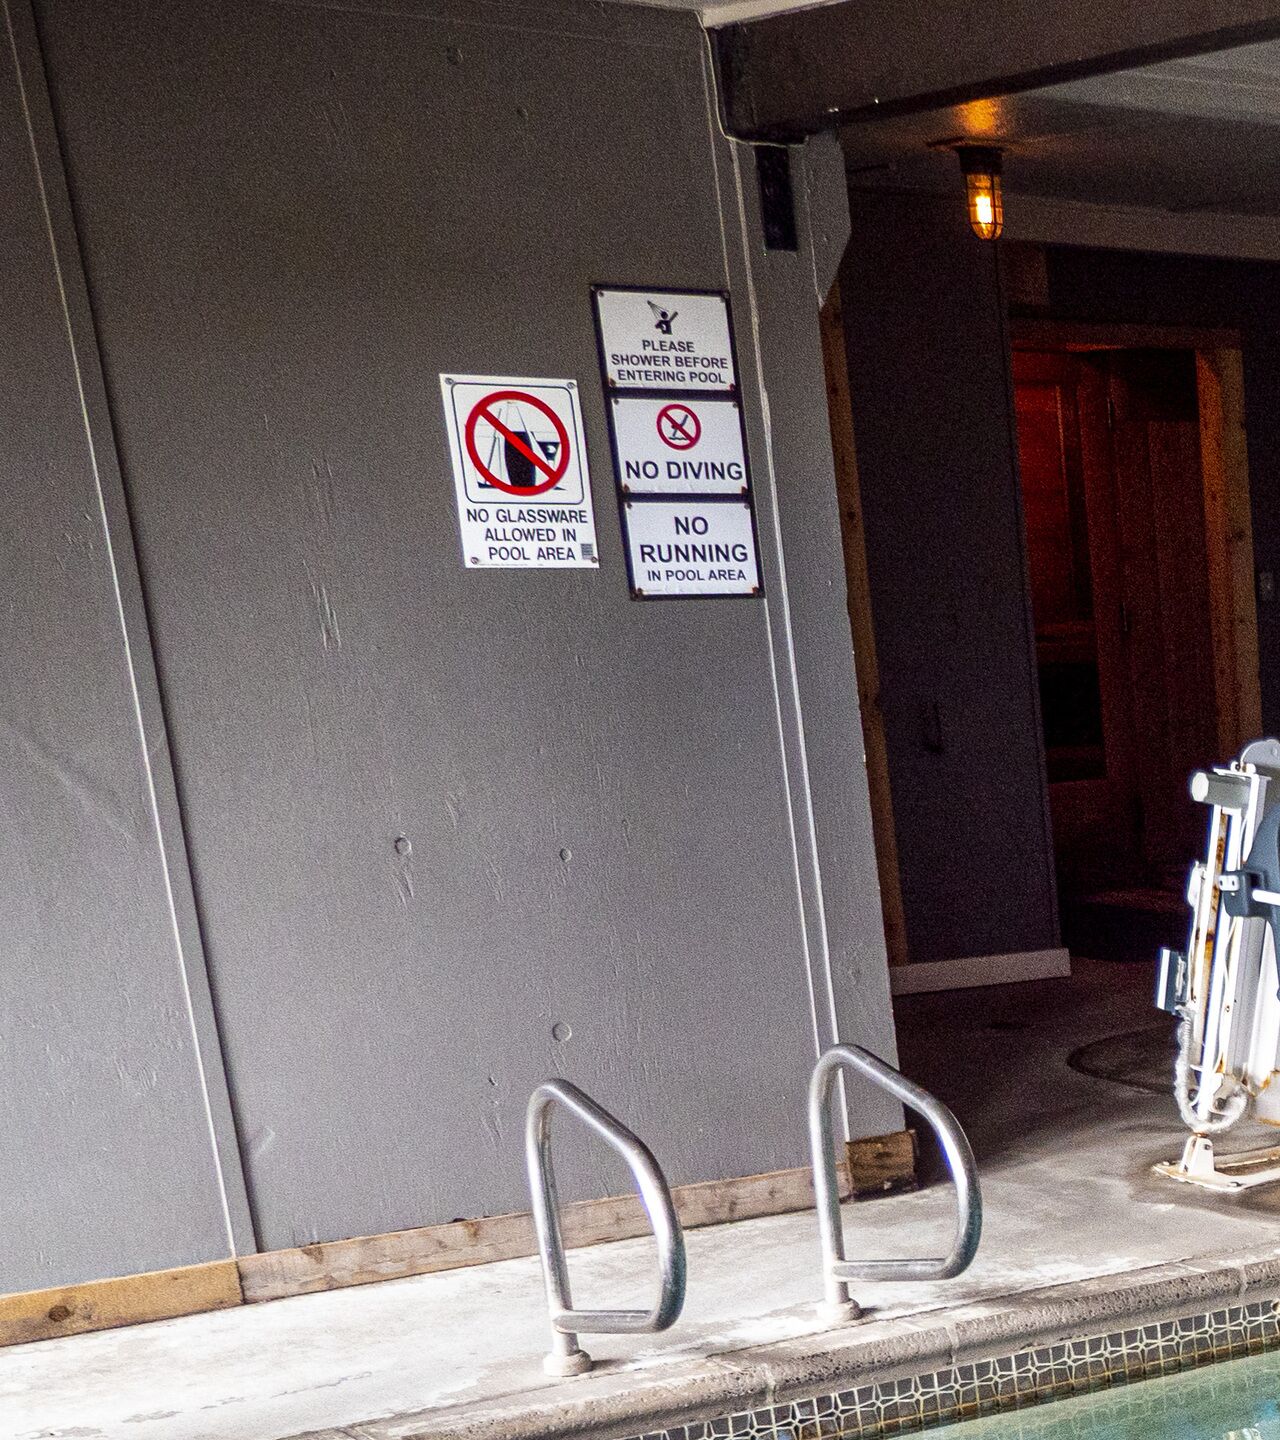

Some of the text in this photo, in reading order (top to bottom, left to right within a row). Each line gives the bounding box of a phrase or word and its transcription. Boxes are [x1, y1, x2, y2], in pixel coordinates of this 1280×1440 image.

[642, 340, 695, 353] PLEASE
[611, 354, 728, 369] SHOWER BEFORE
[617, 369, 726, 384] ENTERING POOL
[625, 460, 743, 480] NO DIVING
[467, 508, 588, 524] NO GLASSWARE
[675, 516, 709, 535] NO
[485, 528, 577, 542] ALLOWED IN
[488, 546, 530, 561] POOL
[537, 547, 576, 561] AREA
[640, 544, 748, 563] RUNNING
[647, 569, 747, 581] IN POOL AREA
